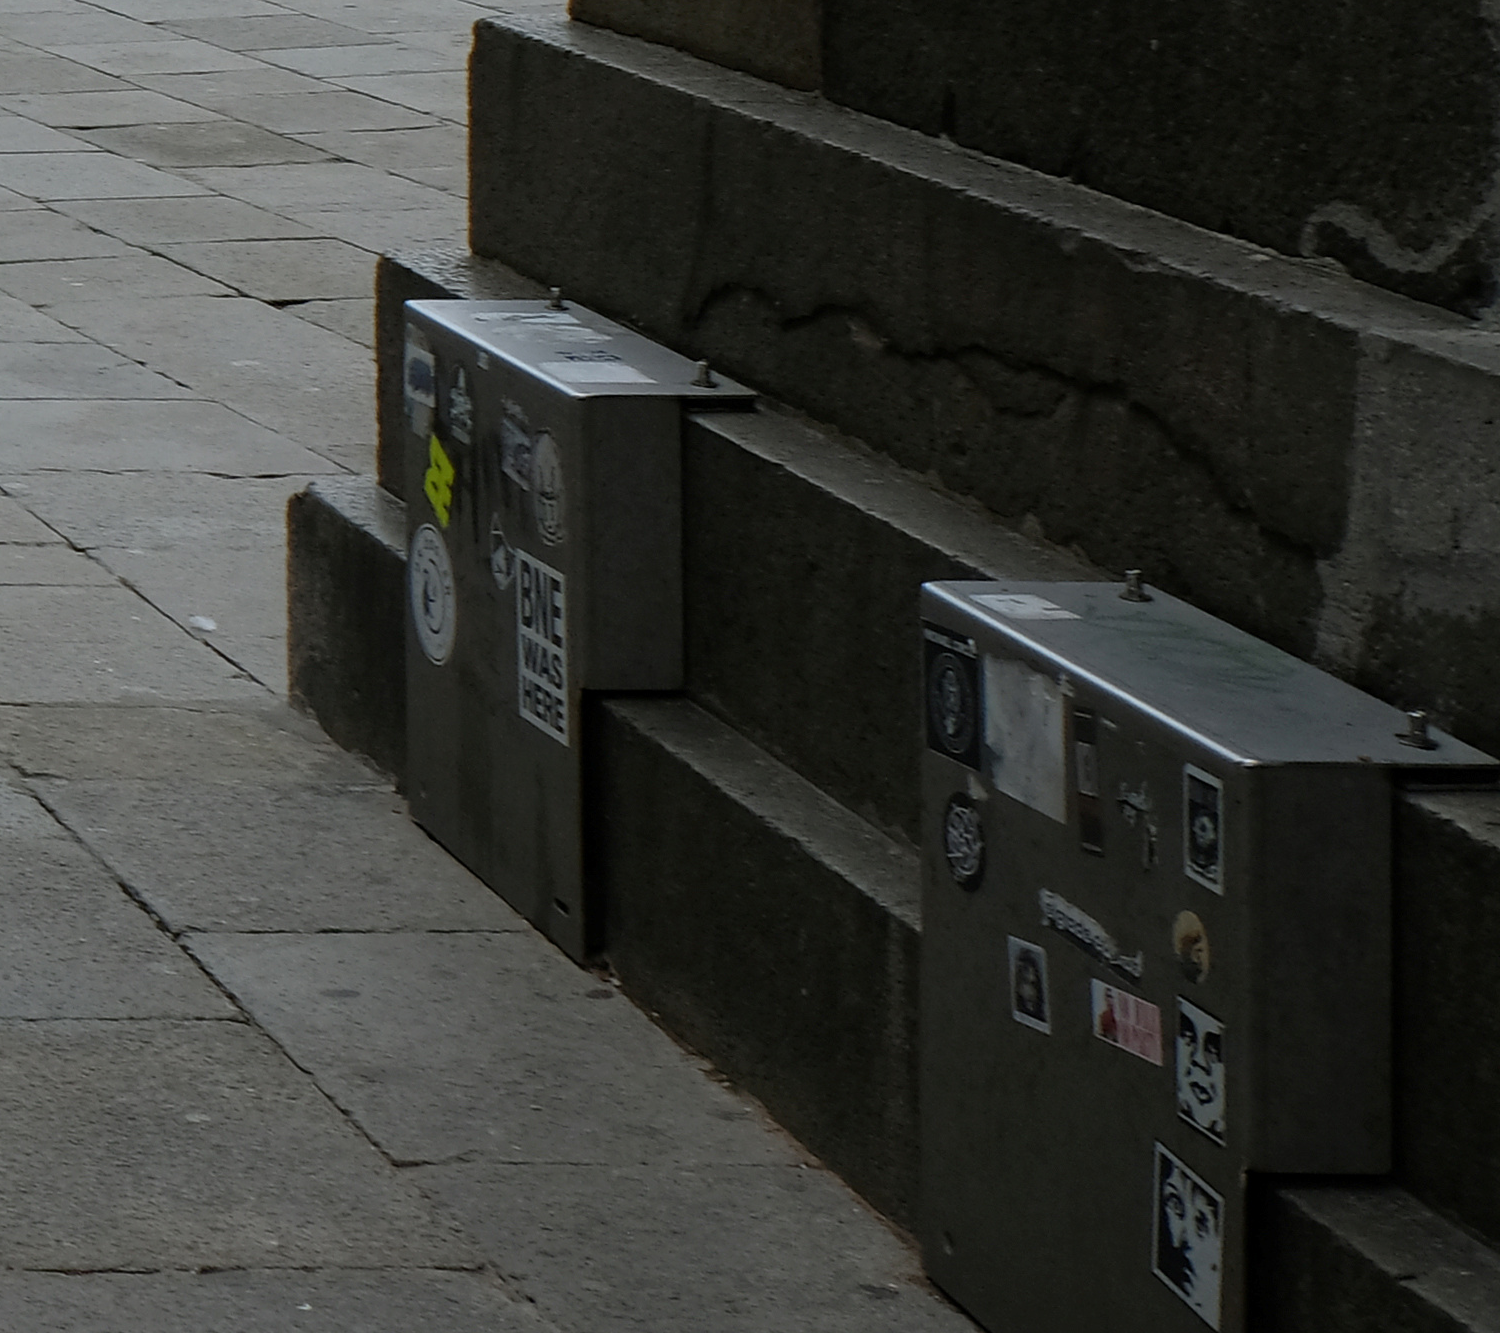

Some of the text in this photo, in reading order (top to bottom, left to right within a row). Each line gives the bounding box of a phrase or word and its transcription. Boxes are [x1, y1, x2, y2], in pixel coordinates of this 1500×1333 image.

[521, 558, 563, 648] BNE
[521, 634, 563, 690] WAS
[522, 675, 566, 733] HERE
